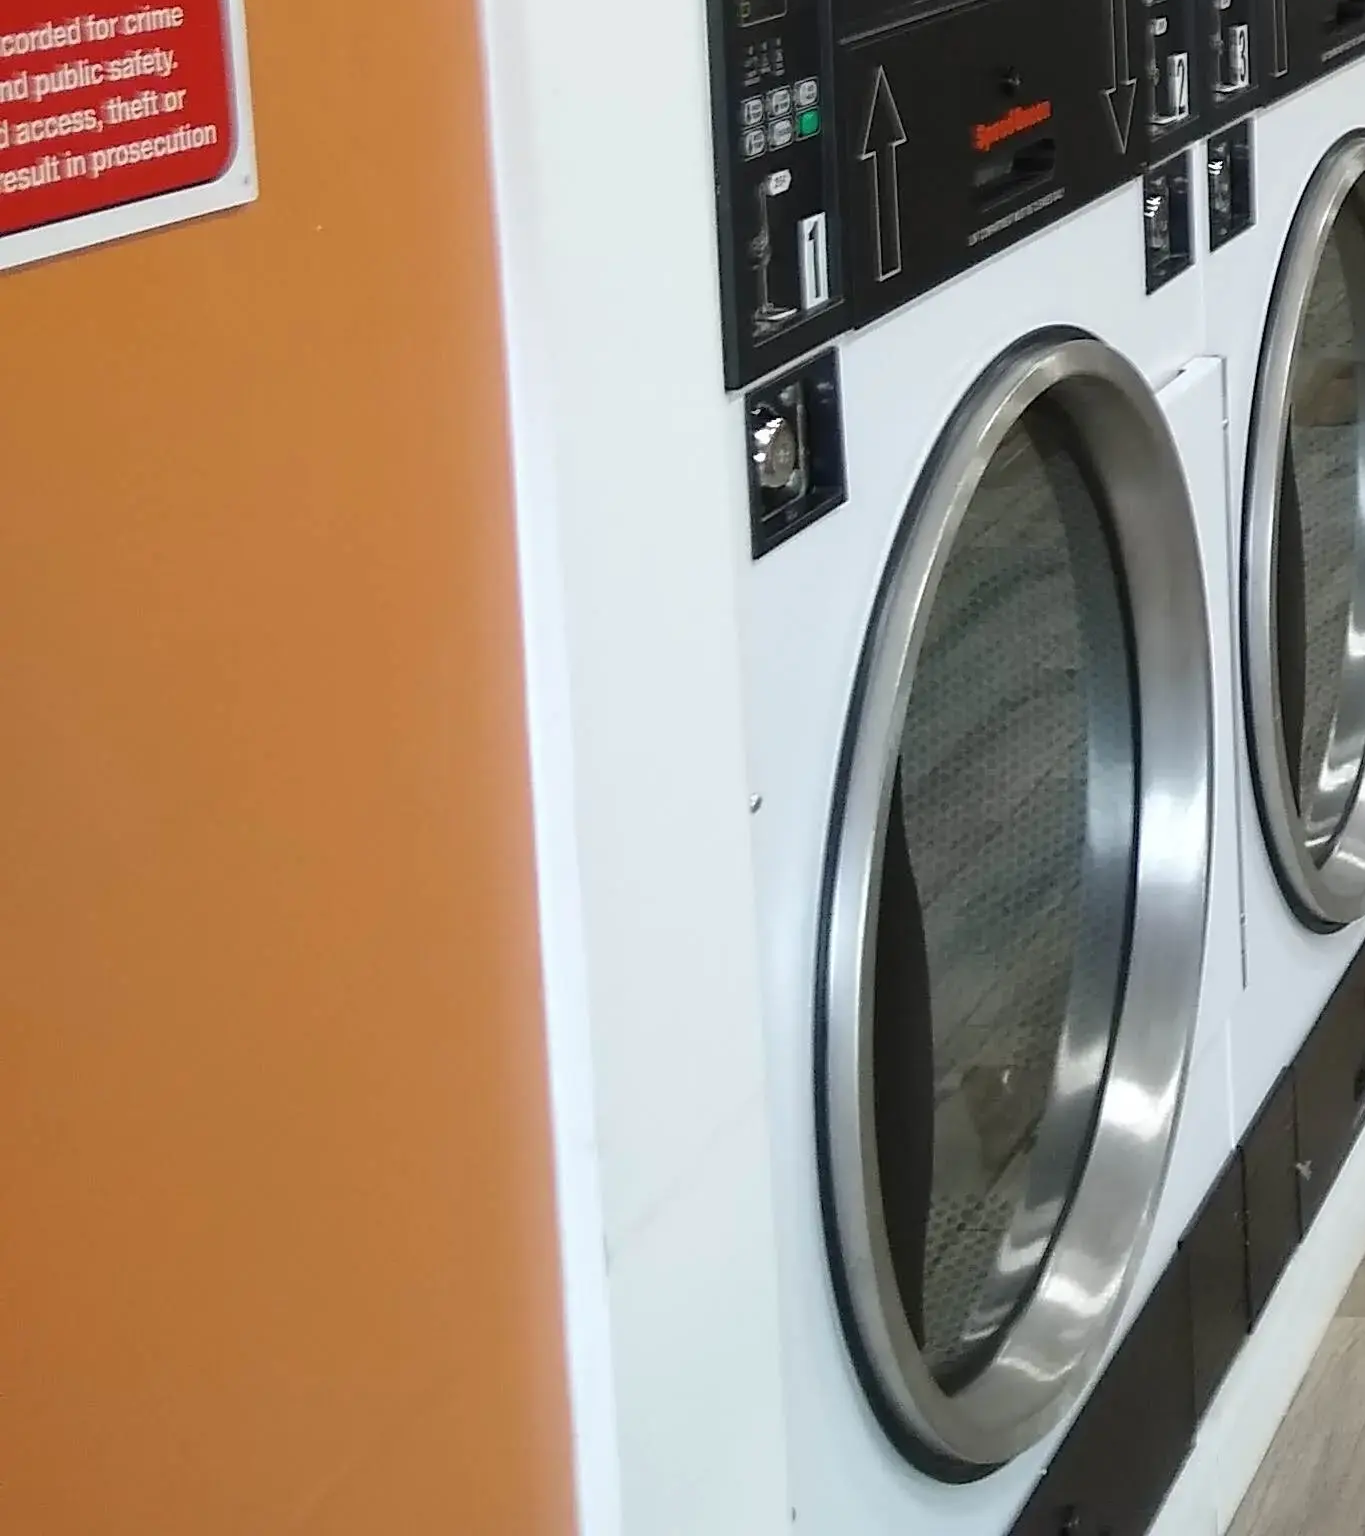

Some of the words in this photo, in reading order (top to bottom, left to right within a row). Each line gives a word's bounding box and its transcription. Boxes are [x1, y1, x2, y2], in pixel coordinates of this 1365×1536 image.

[88, 14, 119, 43] for
[122, 5, 185, 36] crime
[35, 58, 104, 103] public
[105, 47, 179, 81] safety.
[18, 106, 104, 146] access,
[107, 94, 161, 125] theft
[163, 87, 188, 114] or
[65, 149, 88, 179] in
[91, 122, 218, 180] prosecution
[804, 220, 822, 300] 1
